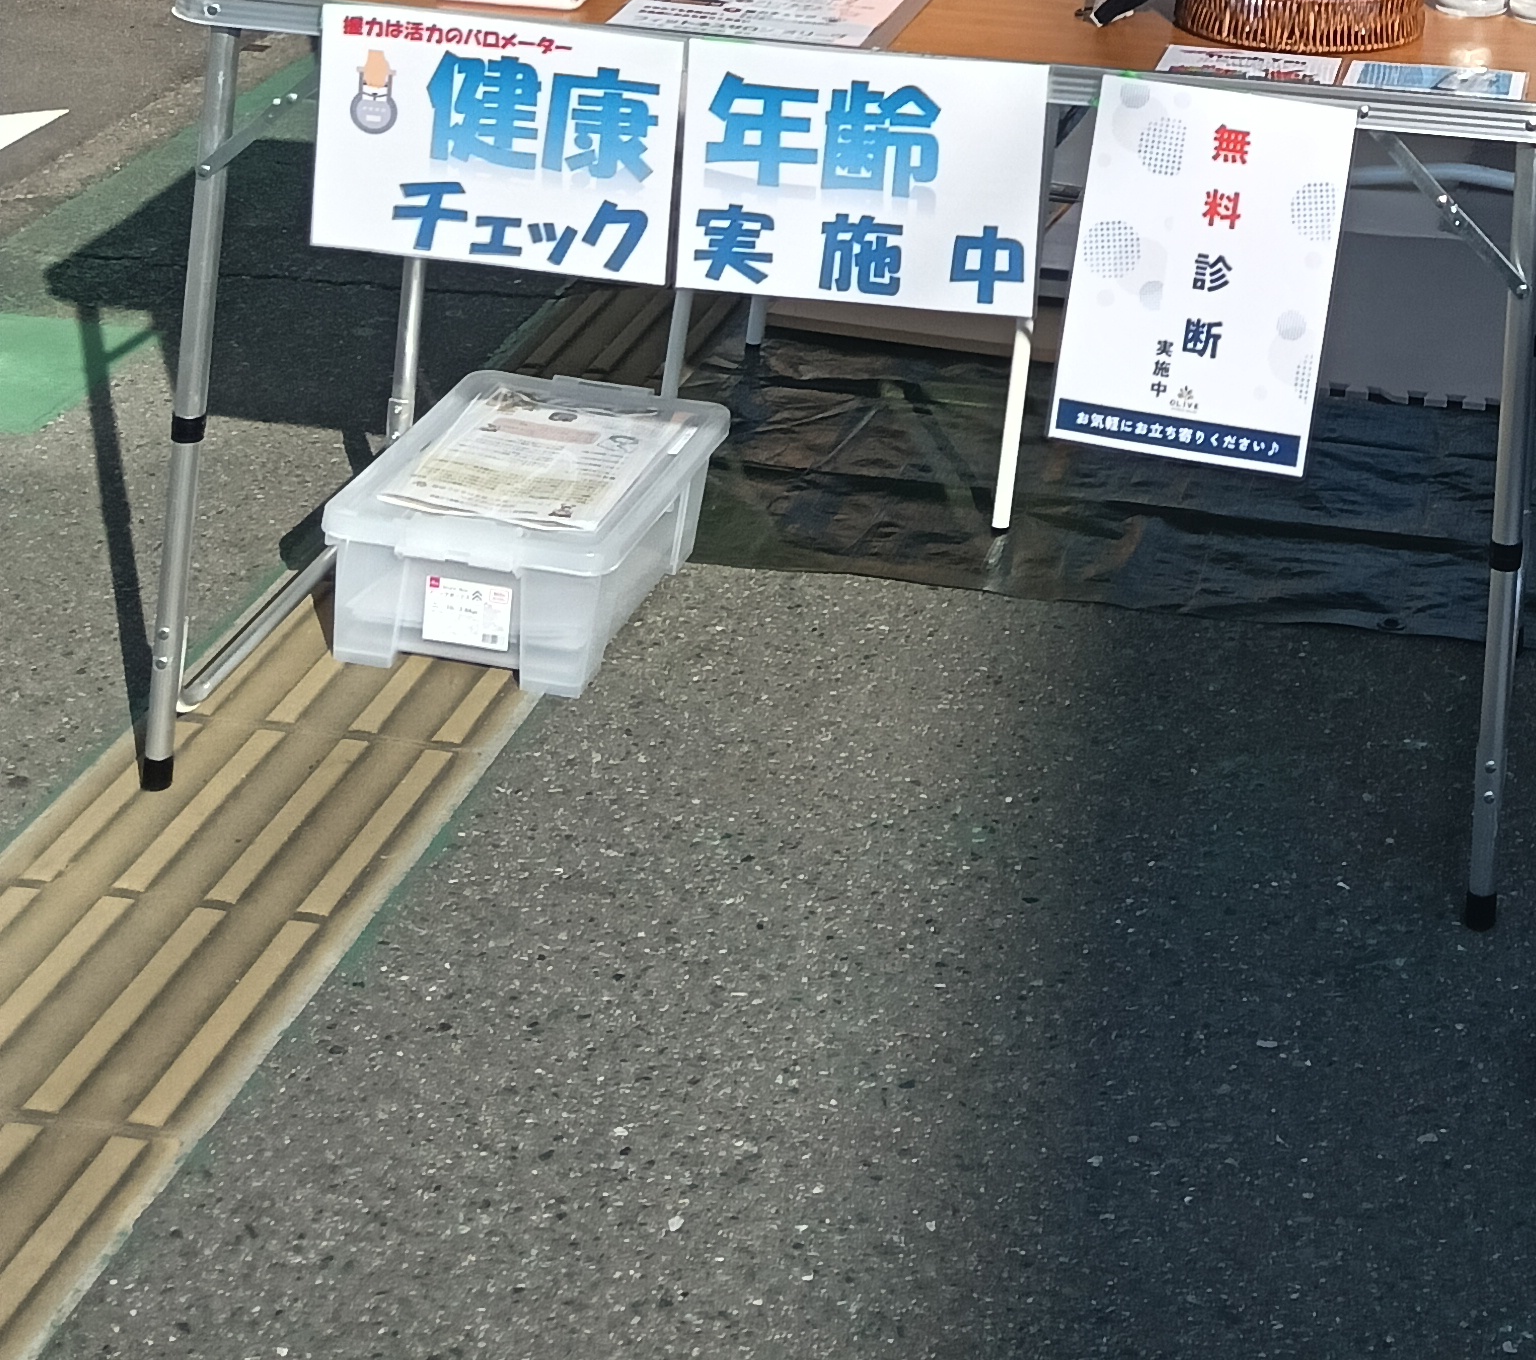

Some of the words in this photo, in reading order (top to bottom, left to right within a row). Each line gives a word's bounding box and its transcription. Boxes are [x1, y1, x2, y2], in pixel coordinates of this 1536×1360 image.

[342, 15, 574, 55] 握力は活力のバロメーター
[426, 50, 661, 183] 健康
[705, 71, 942, 199] 年齢
[392, 181, 649, 273] チェック
[694, 204, 1025, 304] 実施中
[1181, 124, 1251, 360] 無料診断
[1150, 339, 1175, 399] 実施中
